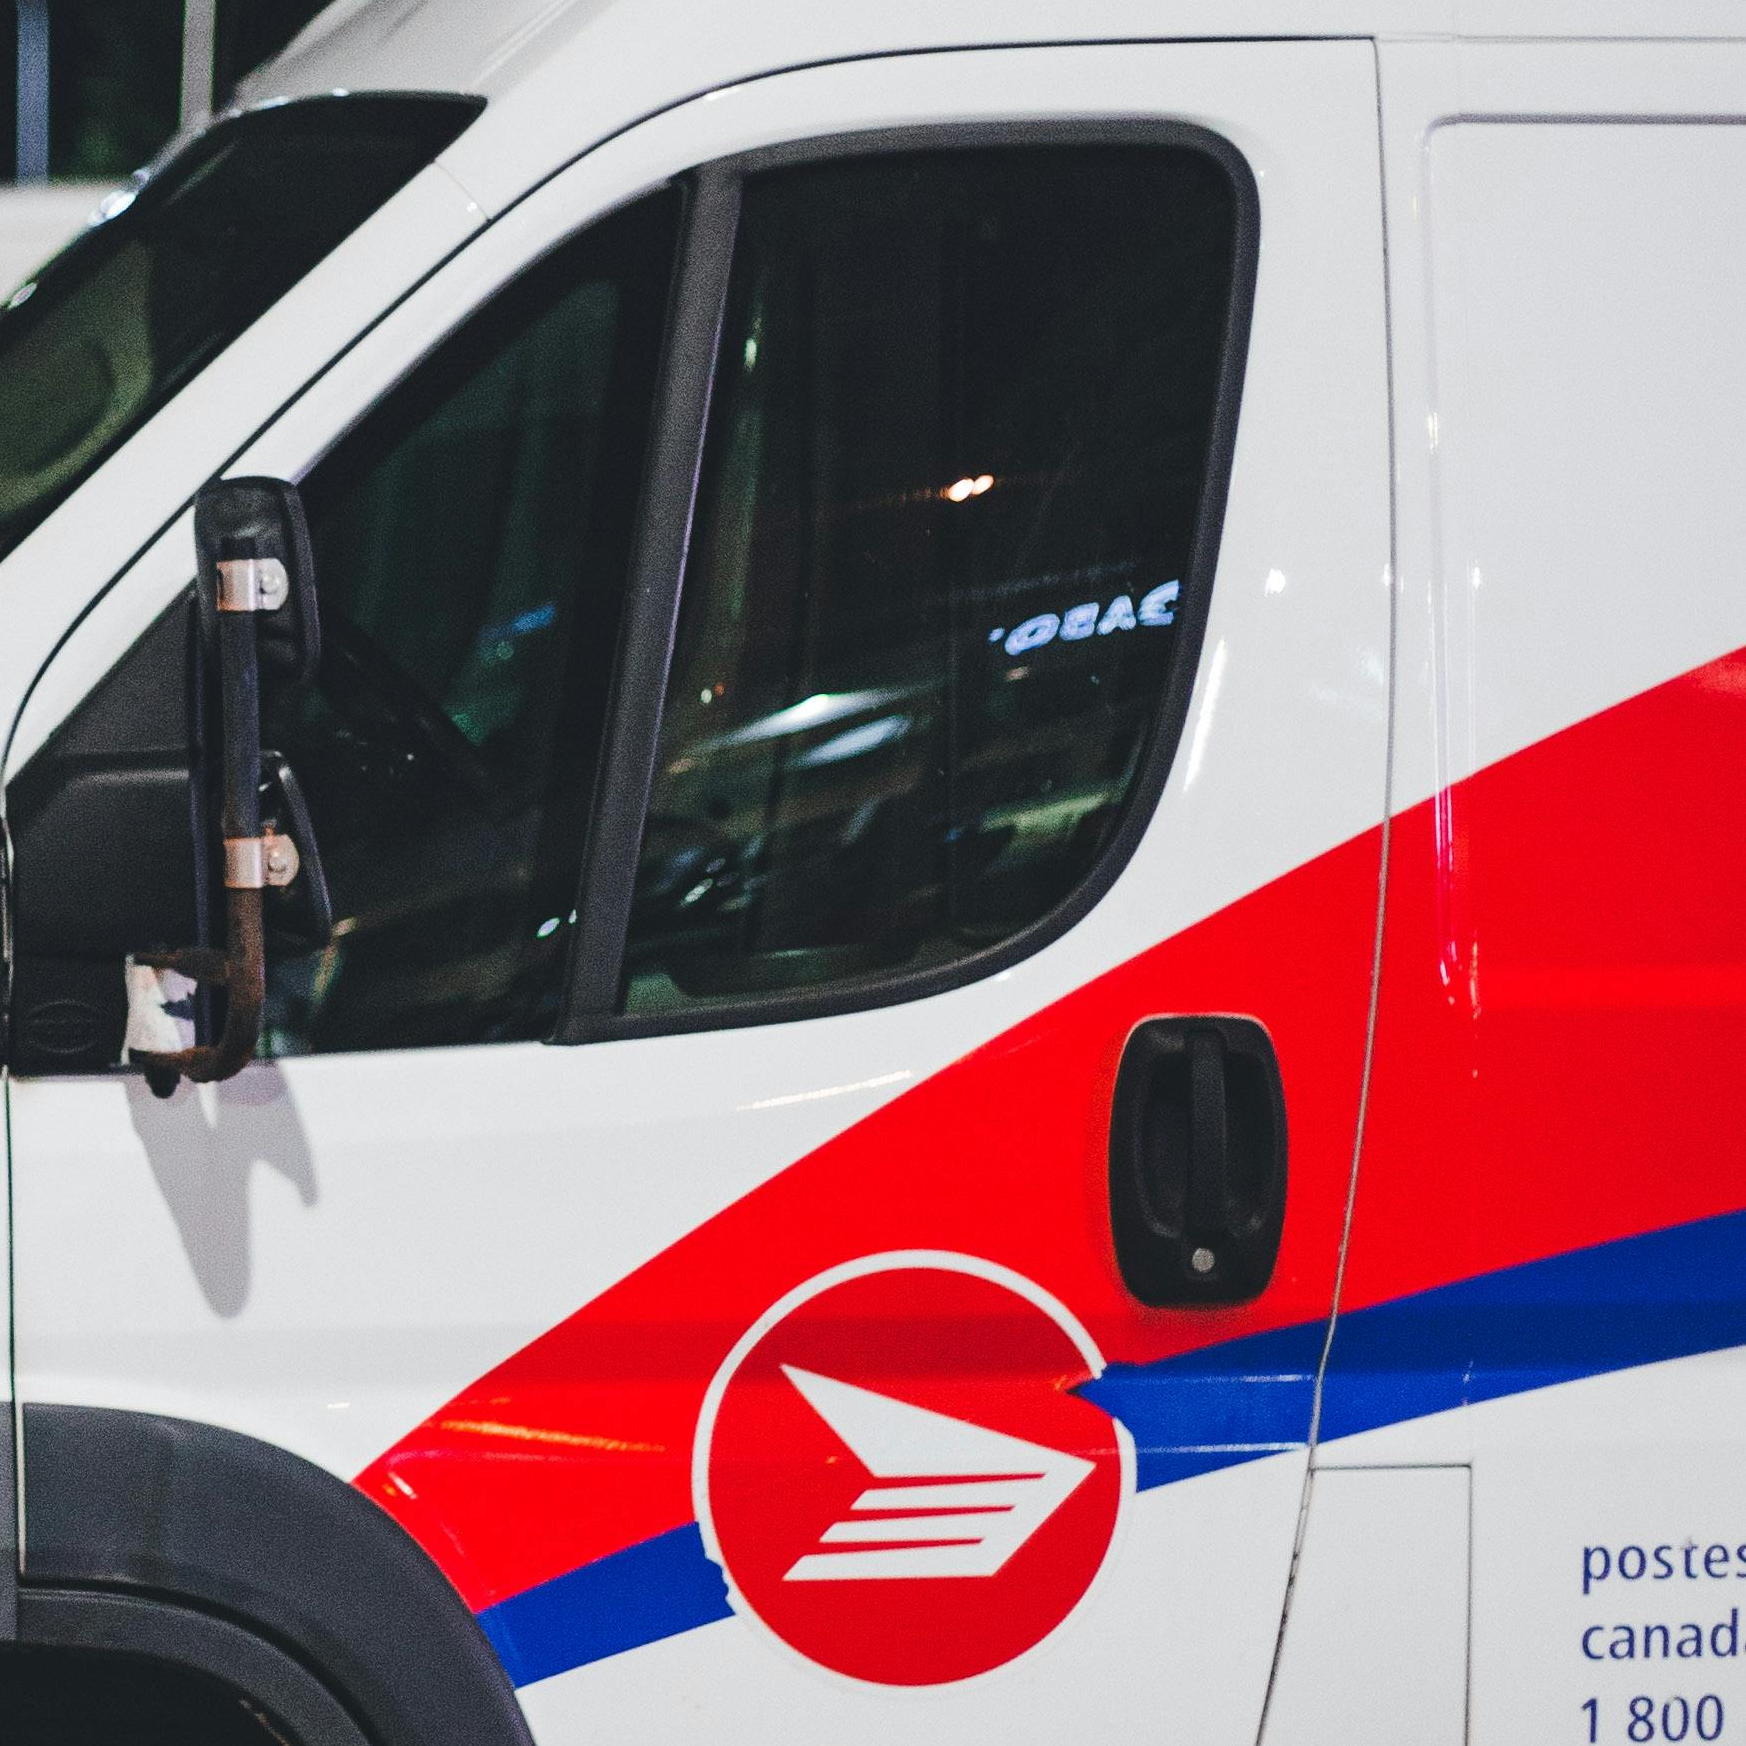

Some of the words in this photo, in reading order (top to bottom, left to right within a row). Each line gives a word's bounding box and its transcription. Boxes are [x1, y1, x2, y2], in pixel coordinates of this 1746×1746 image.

[1581, 1607, 1746, 1661] canad
[1581, 1697, 1598, 1744] 1
[1627, 1693, 1724, 1744] 800
